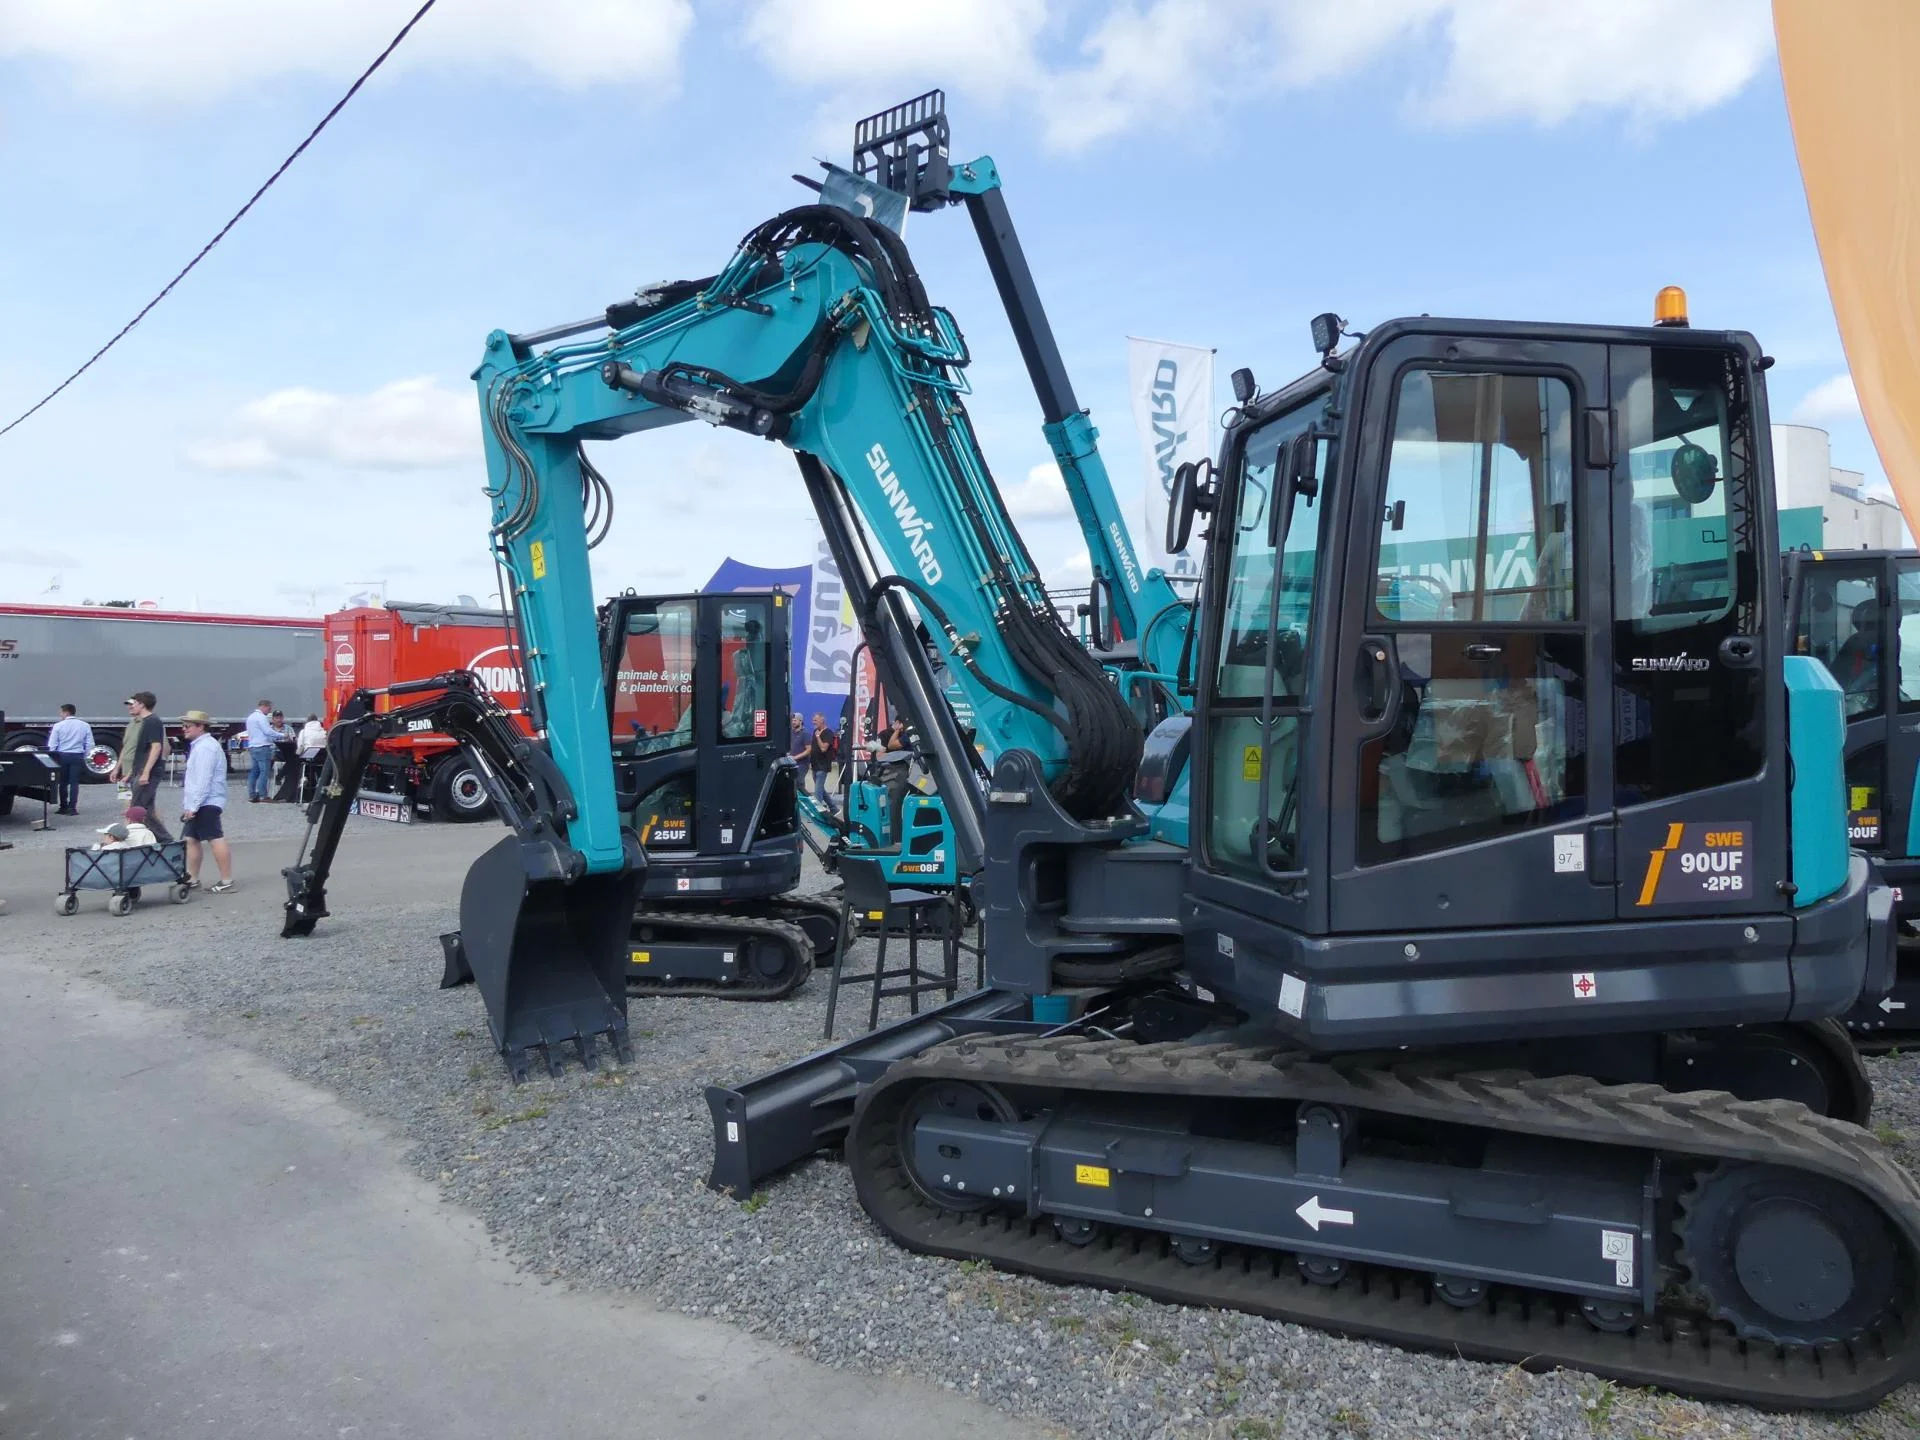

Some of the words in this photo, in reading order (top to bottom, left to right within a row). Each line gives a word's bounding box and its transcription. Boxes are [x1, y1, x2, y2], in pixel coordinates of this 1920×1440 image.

[865, 443, 942, 586] SUNWARD
[1109, 522, 1139, 593] SUNWARD
[1632, 652, 1710, 671] SUNWARD
[617, 669, 658, 680] animale
[661, 670, 668, 681] &
[619, 682, 627, 692] &
[362, 801, 397, 818] KEMPF
[663, 820, 686, 828] SWE
[1858, 816, 1878, 825] SWE
[654, 830, 687, 840] 25UF
[1705, 831, 1744, 847] SWE
[1558, 853, 1573, 865] 97
[1681, 851, 1744, 874] 90UF
[1702, 875, 1744, 892] -2PB
